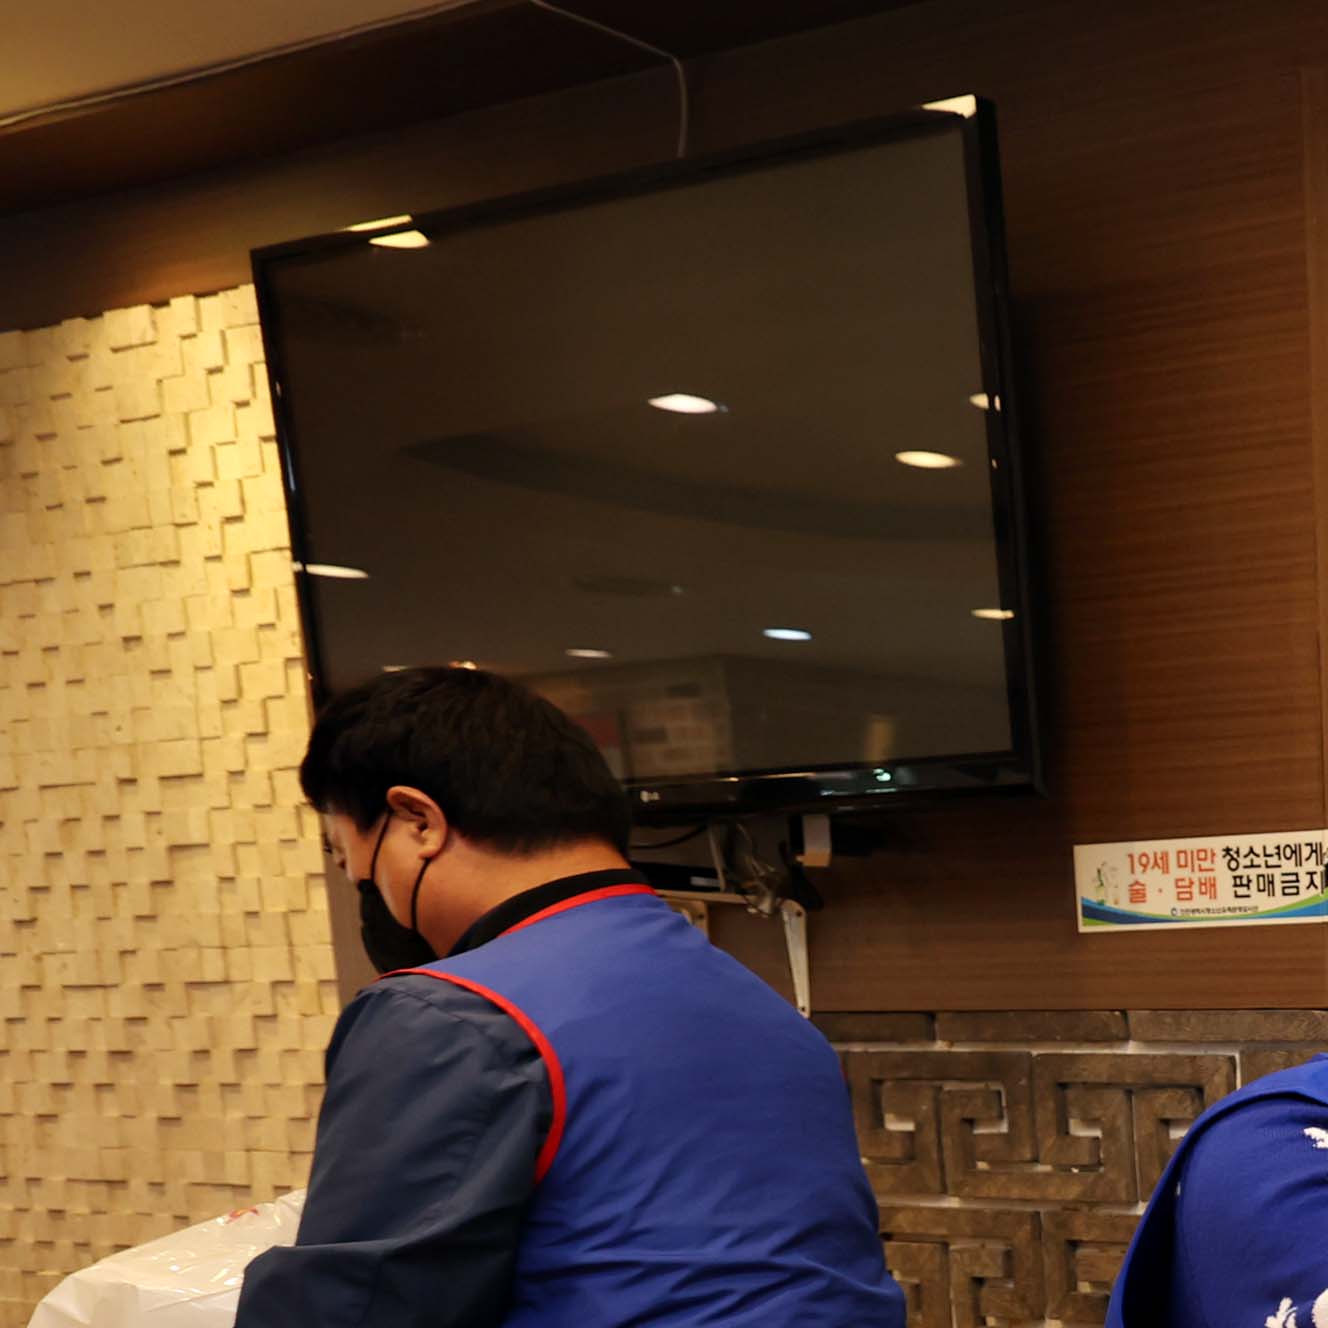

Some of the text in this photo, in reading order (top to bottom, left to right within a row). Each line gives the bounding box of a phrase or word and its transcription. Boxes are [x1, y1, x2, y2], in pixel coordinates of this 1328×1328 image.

[1126, 841, 1325, 875] 19세 미만 청소년에게
[1127, 880, 1148, 904] 술
[1175, 875, 1218, 902] 담배
[1231, 871, 1326, 899] 판매금지
